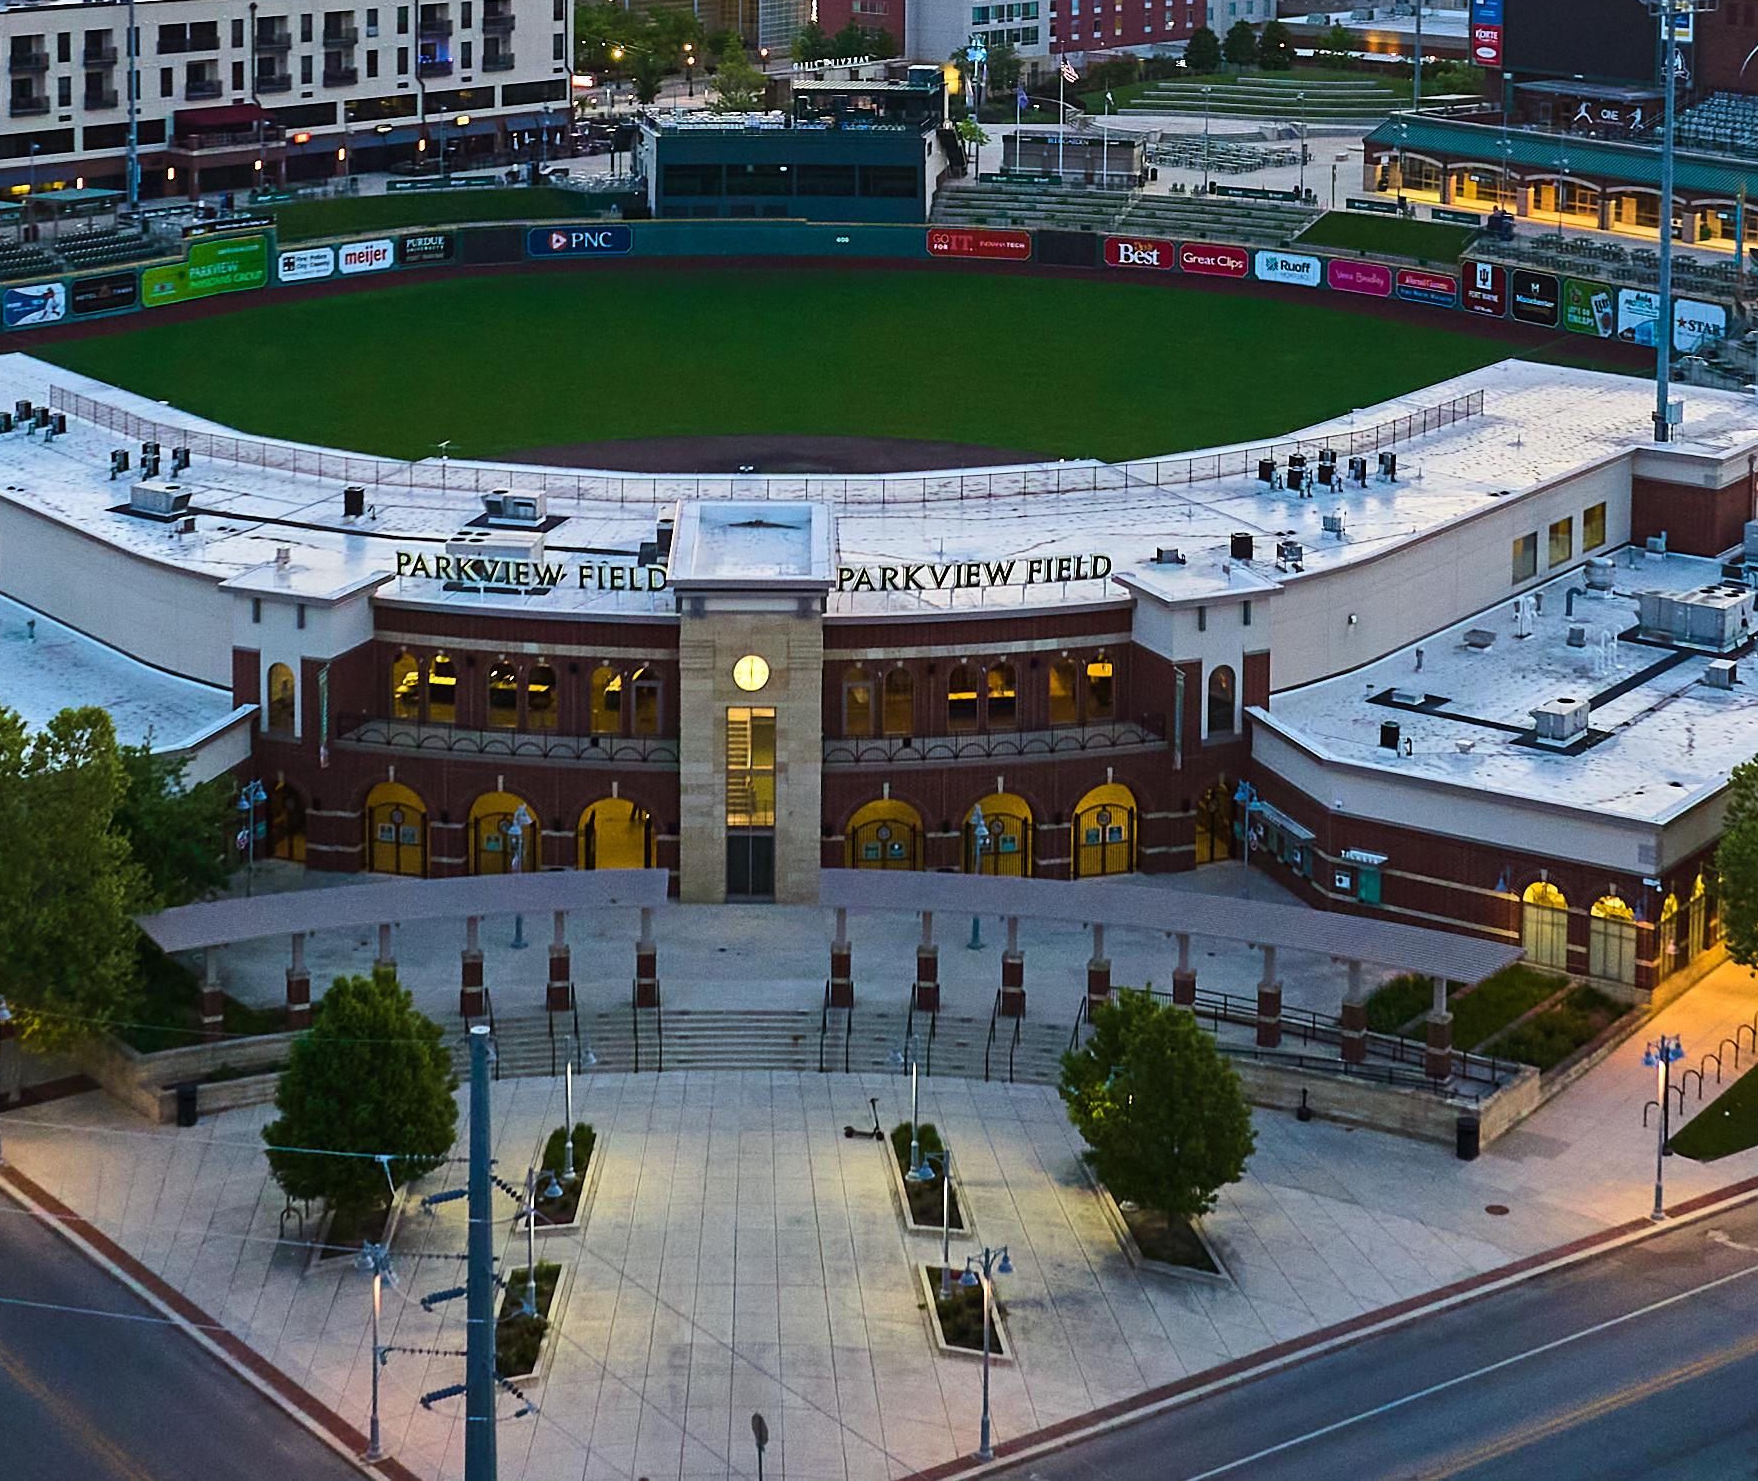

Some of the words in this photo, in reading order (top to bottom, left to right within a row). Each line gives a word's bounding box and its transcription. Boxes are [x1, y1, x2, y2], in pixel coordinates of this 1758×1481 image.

[406, 236, 445, 248] PURDUE
[572, 231, 613, 248] PNC
[933, 233, 949, 243] GO
[1006, 241, 1026, 249] TECH
[344, 245, 388, 267] meijer
[1118, 242, 1161, 266] Best
[1182, 251, 1215, 266] Great
[1216, 255, 1245, 270] Clips
[189, 260, 239, 280] PARKVIEW
[1280, 259, 1311, 273] Ruoff
[233, 270, 263, 282] GROUP
[1335, 269, 1354, 281] Vera
[1355, 271, 1385, 287] Bradley
[1688, 320, 1721, 336] STAR
[396, 550, 566, 588] PARKVIEW
[579, 563, 668, 592] FIELD
[837, 559, 1017, 592] PARKVIEW
[1026, 553, 1112, 584] FIELD
